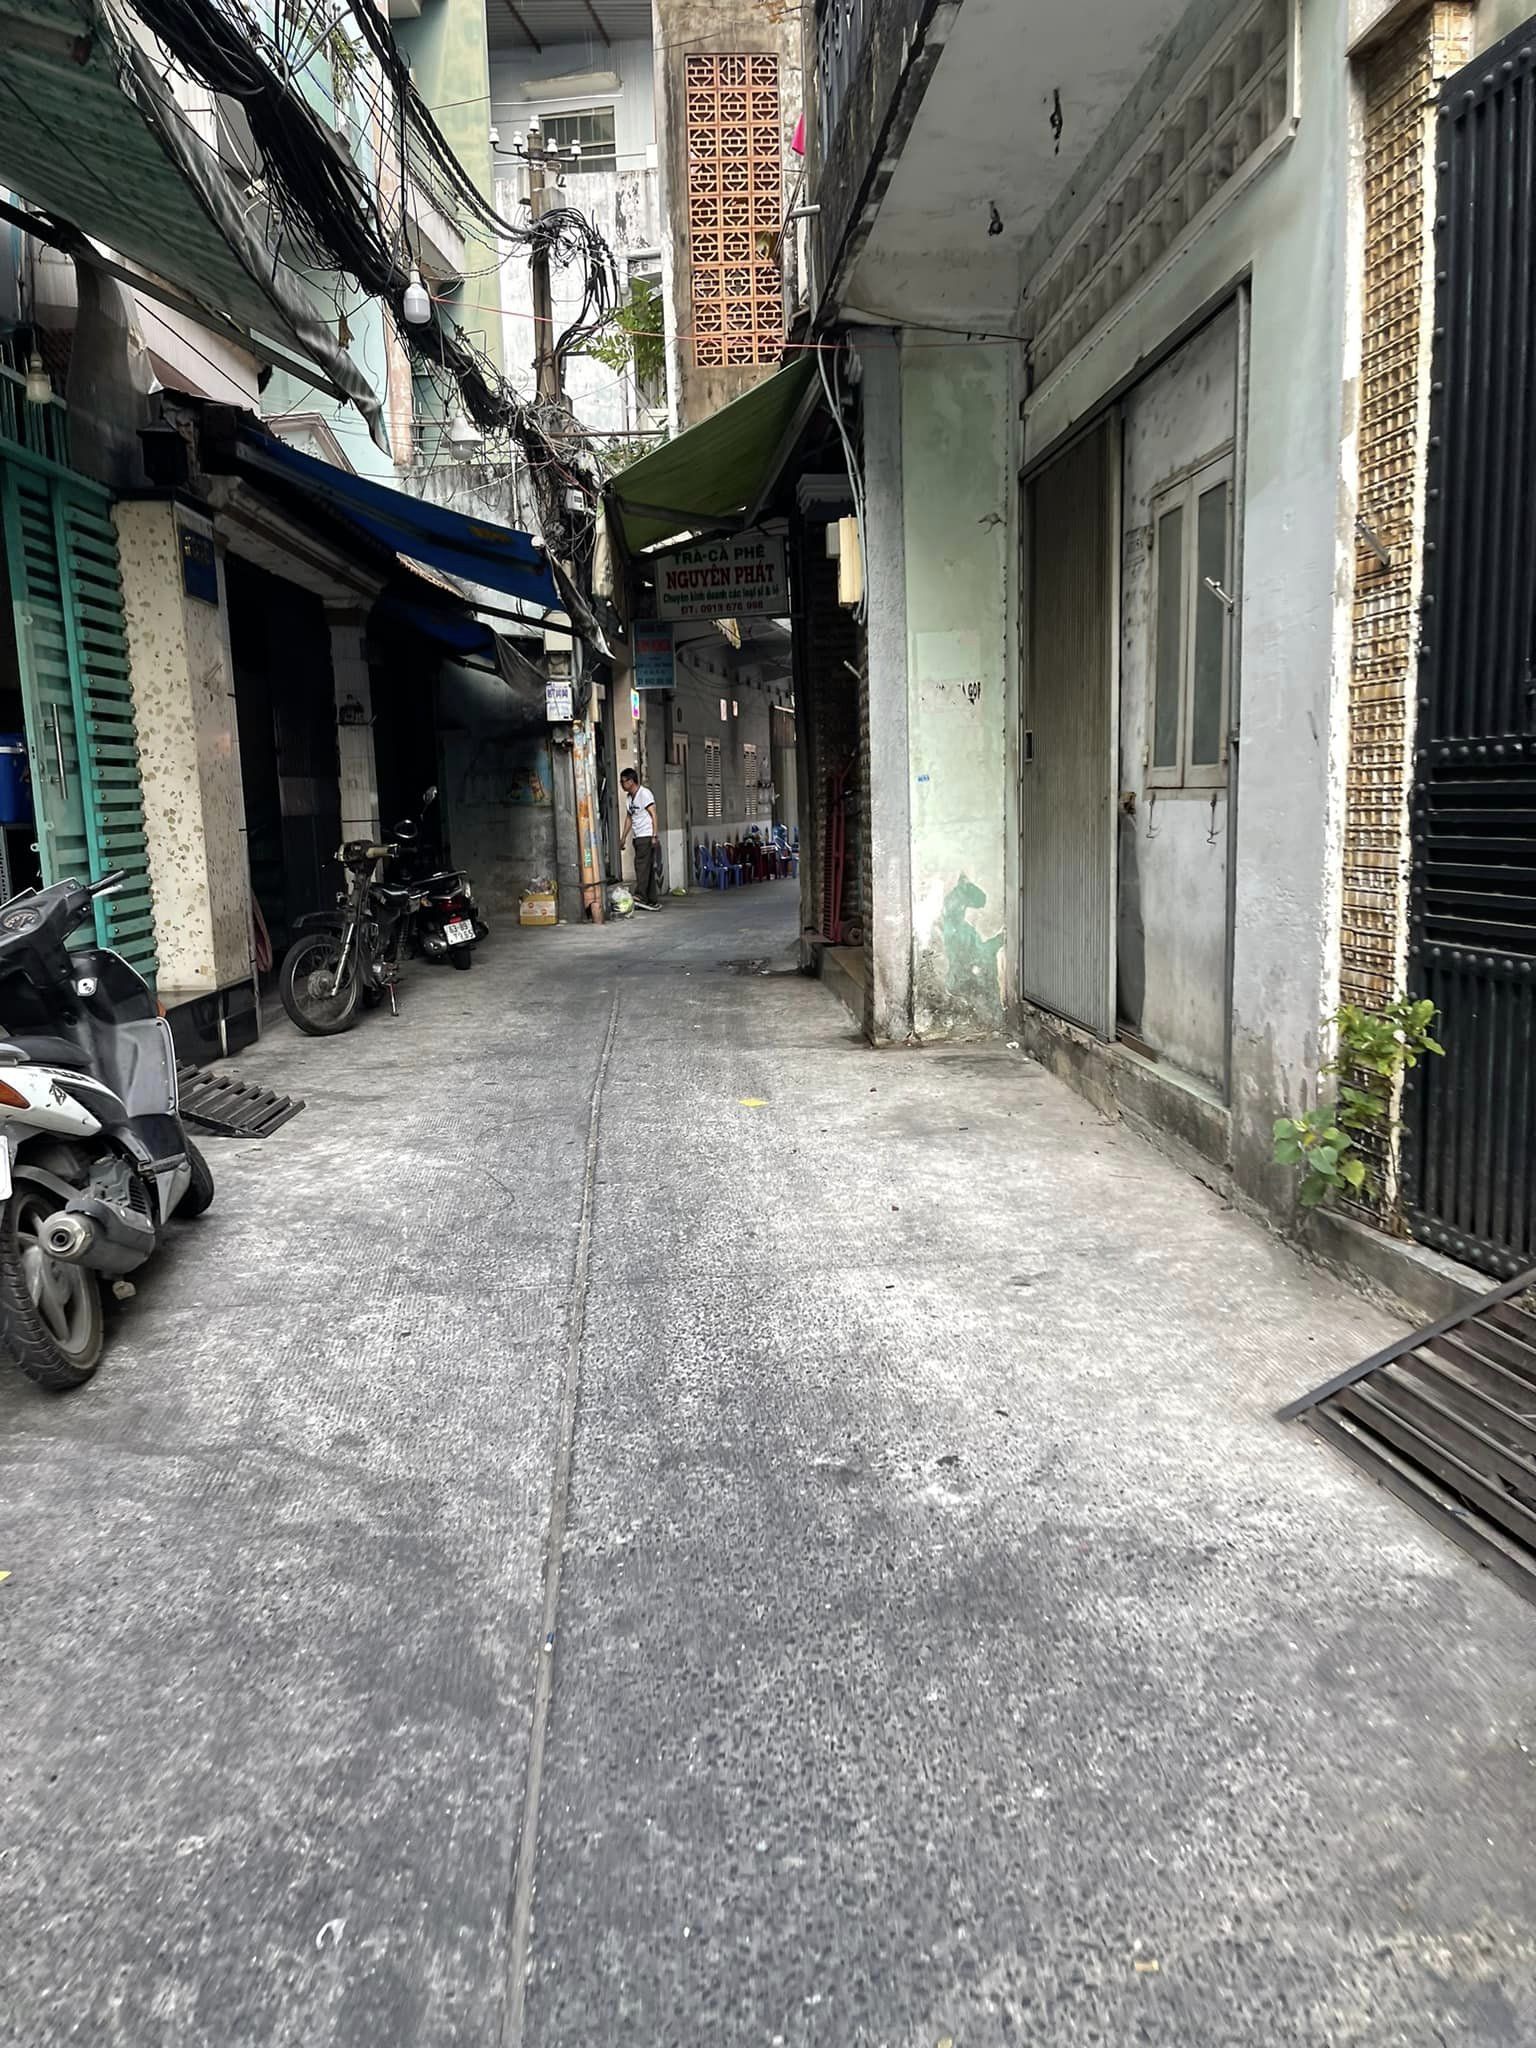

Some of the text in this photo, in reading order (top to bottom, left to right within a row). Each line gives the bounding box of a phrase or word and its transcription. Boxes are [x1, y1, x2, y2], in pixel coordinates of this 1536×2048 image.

[734, 544, 765, 560] PHÊ
[666, 560, 775, 590] NGUYÊN PHÁT
